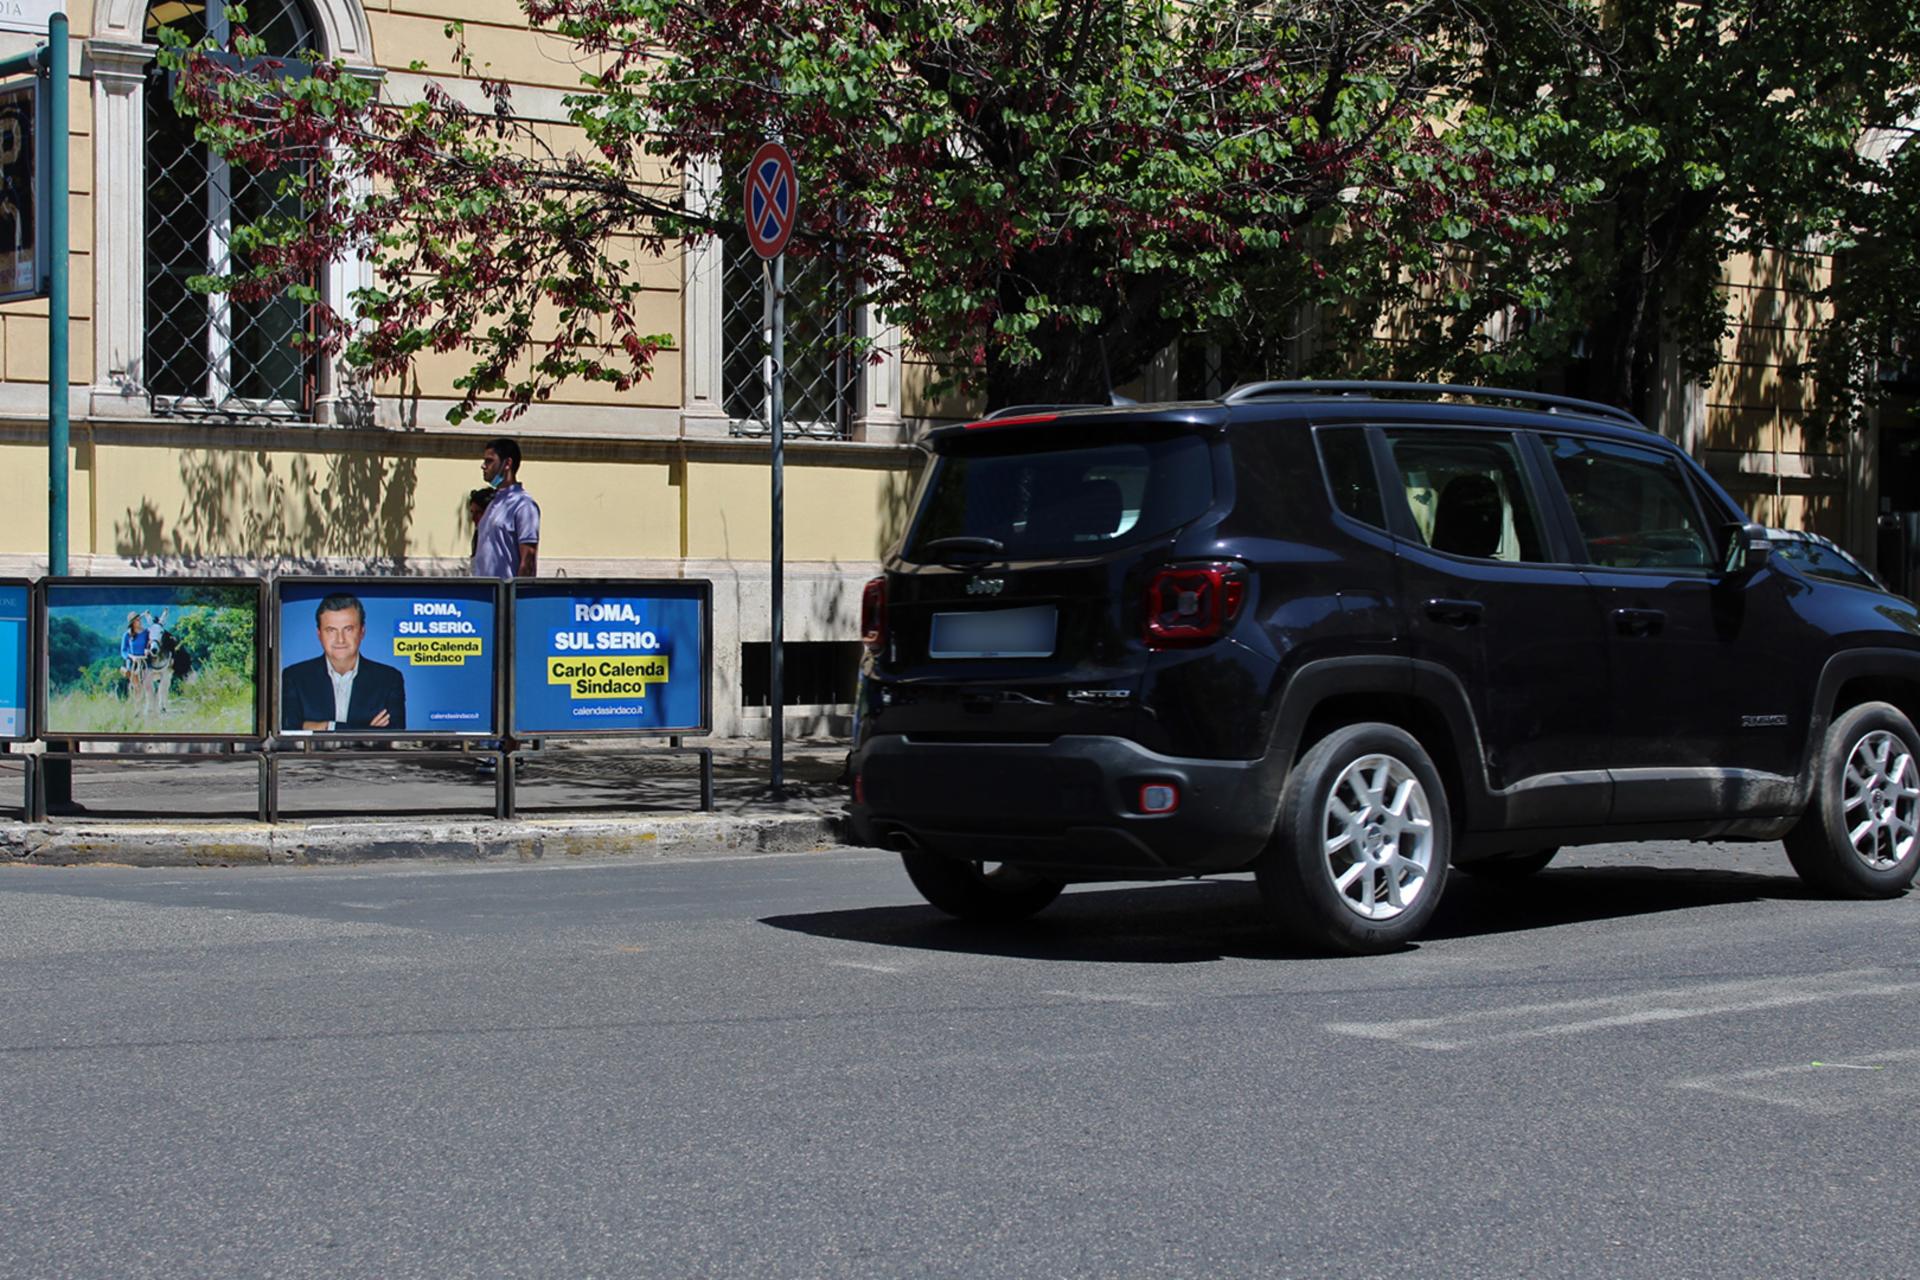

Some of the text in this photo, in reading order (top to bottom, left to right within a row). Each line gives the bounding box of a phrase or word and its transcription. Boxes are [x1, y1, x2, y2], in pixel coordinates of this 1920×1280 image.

[966, 575, 1004, 597] Jeep
[413, 603, 462, 618] ROMA,
[575, 604, 641, 625] ROMA,
[399, 621, 476, 634] SUL SERIO.
[397, 641, 479, 652] Carlo Calenda
[554, 631, 660, 650] SUL SERIO.
[414, 653, 462, 663] Sindaco
[552, 661, 665, 678] Carlo Calenda
[576, 679, 642, 694] Sindaco
[572, 705, 643, 716] calendasindaco.it
